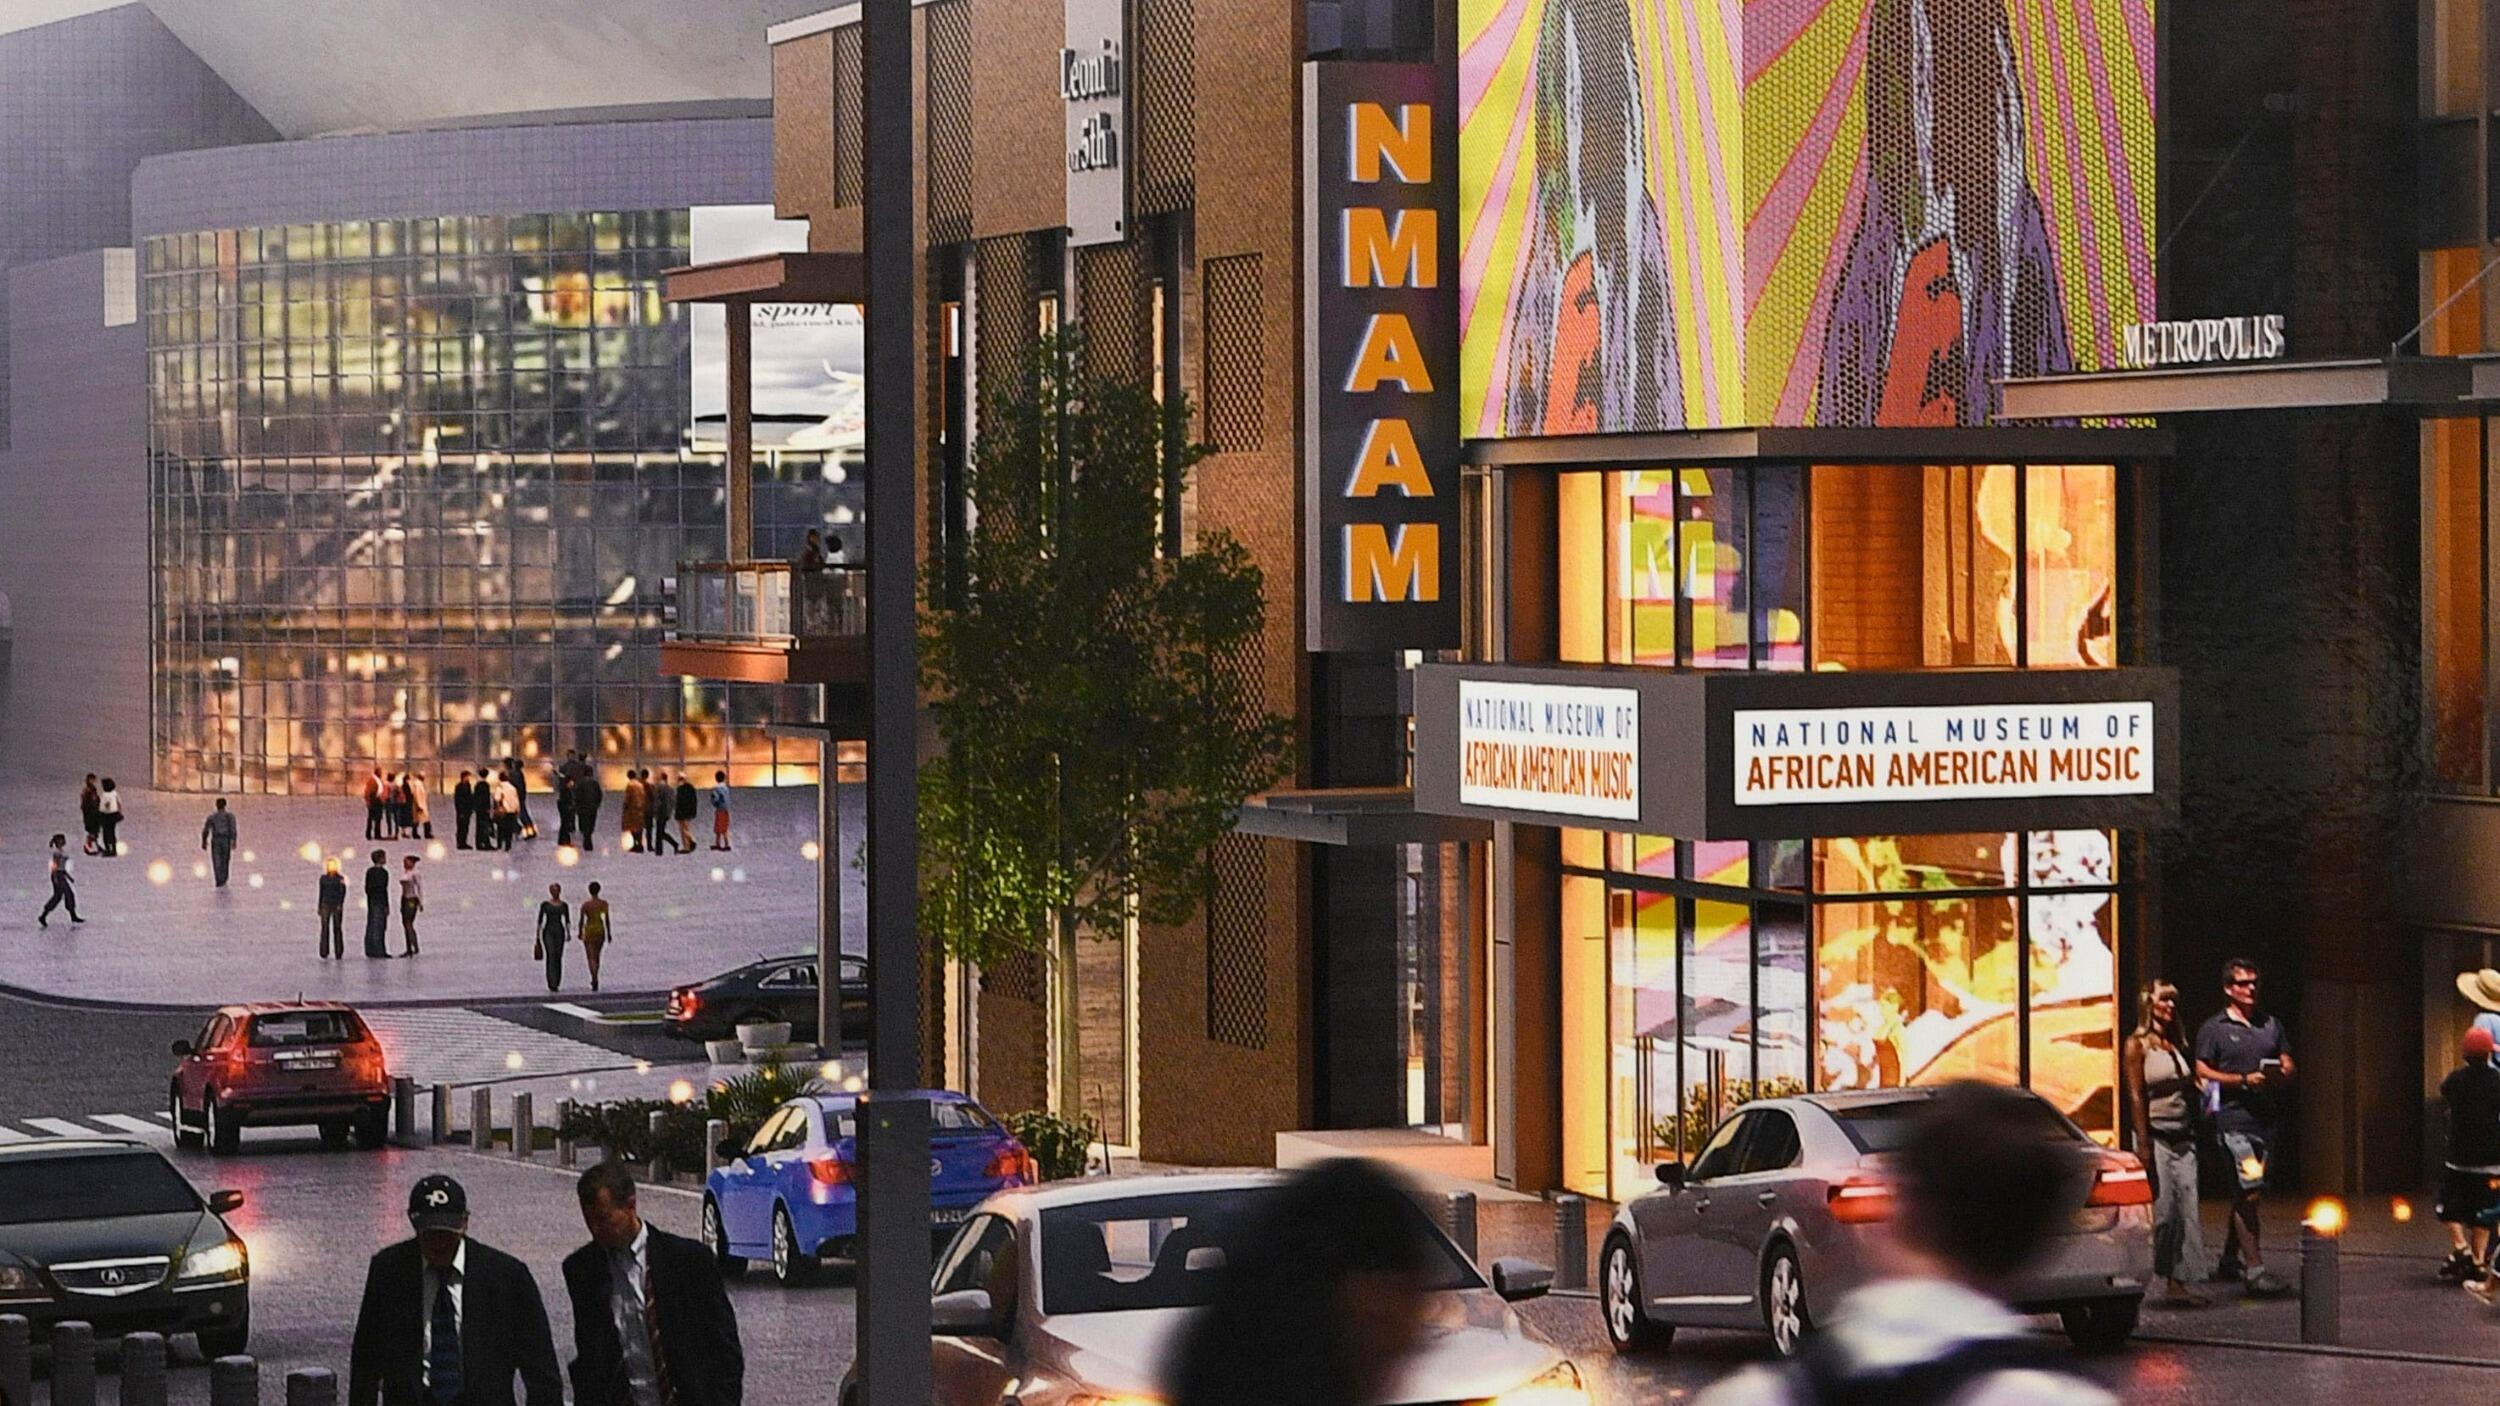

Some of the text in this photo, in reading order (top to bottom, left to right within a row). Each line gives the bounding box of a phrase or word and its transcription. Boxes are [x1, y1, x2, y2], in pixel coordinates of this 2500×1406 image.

[1342, 103, 1439, 602] NMAAM
[2122, 314, 2285, 369] METROPOLIS
[1465, 698, 1632, 739] NATIONAL MUSEUM OF
[1752, 714, 2141, 747] NATIONAL MUSEUM OF
[1465, 741, 1633, 800] AFRICAN AMERICAN MUSIC
[1747, 746, 2141, 791] AFRICAN AMERICAN MUSIC
